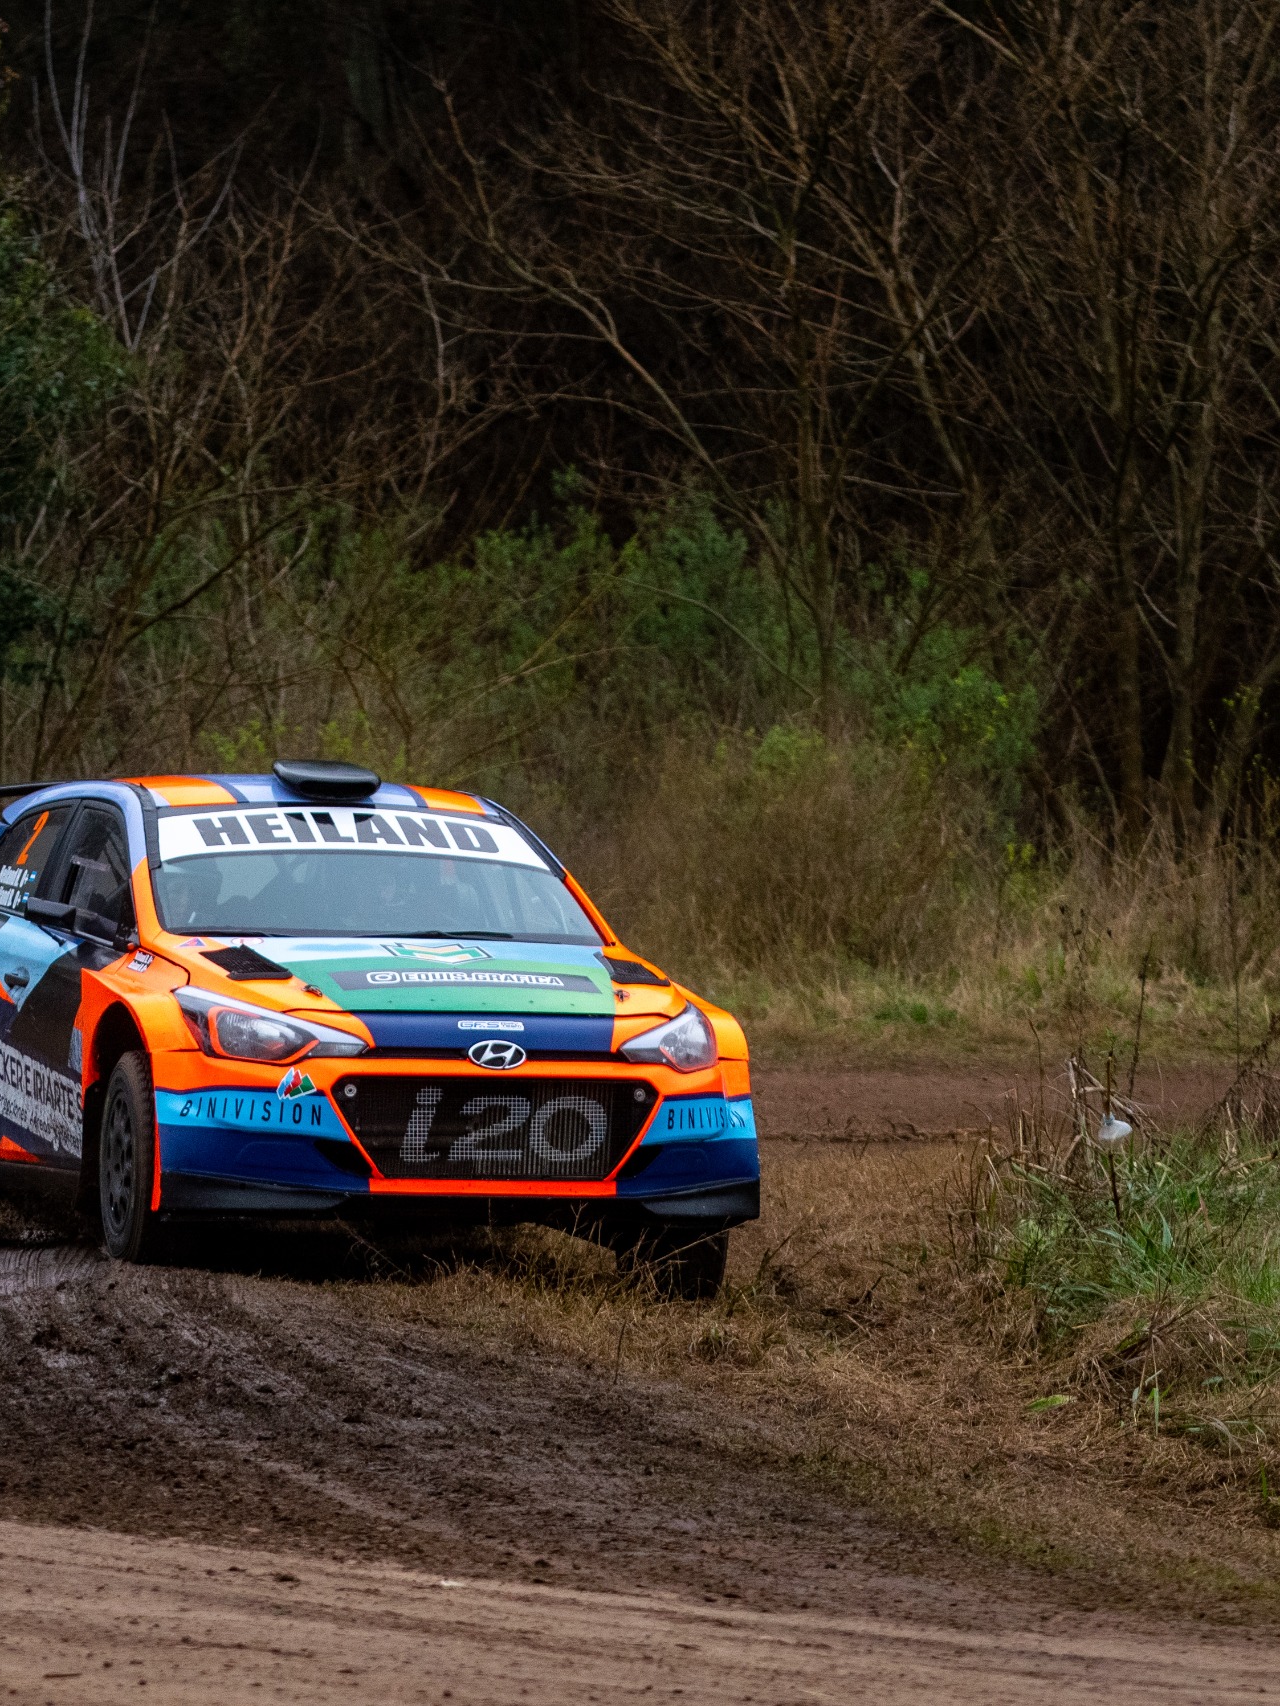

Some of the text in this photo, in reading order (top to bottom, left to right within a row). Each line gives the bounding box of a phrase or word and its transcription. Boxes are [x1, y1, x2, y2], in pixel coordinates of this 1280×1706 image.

[16, 811, 50, 865] 2
[192, 812, 499, 853] HEILAND
[33, 1069, 75, 1120] IRIARTE
[180, 1097, 321, 1125] BINIVISION
[400, 1086, 607, 1162] i20
